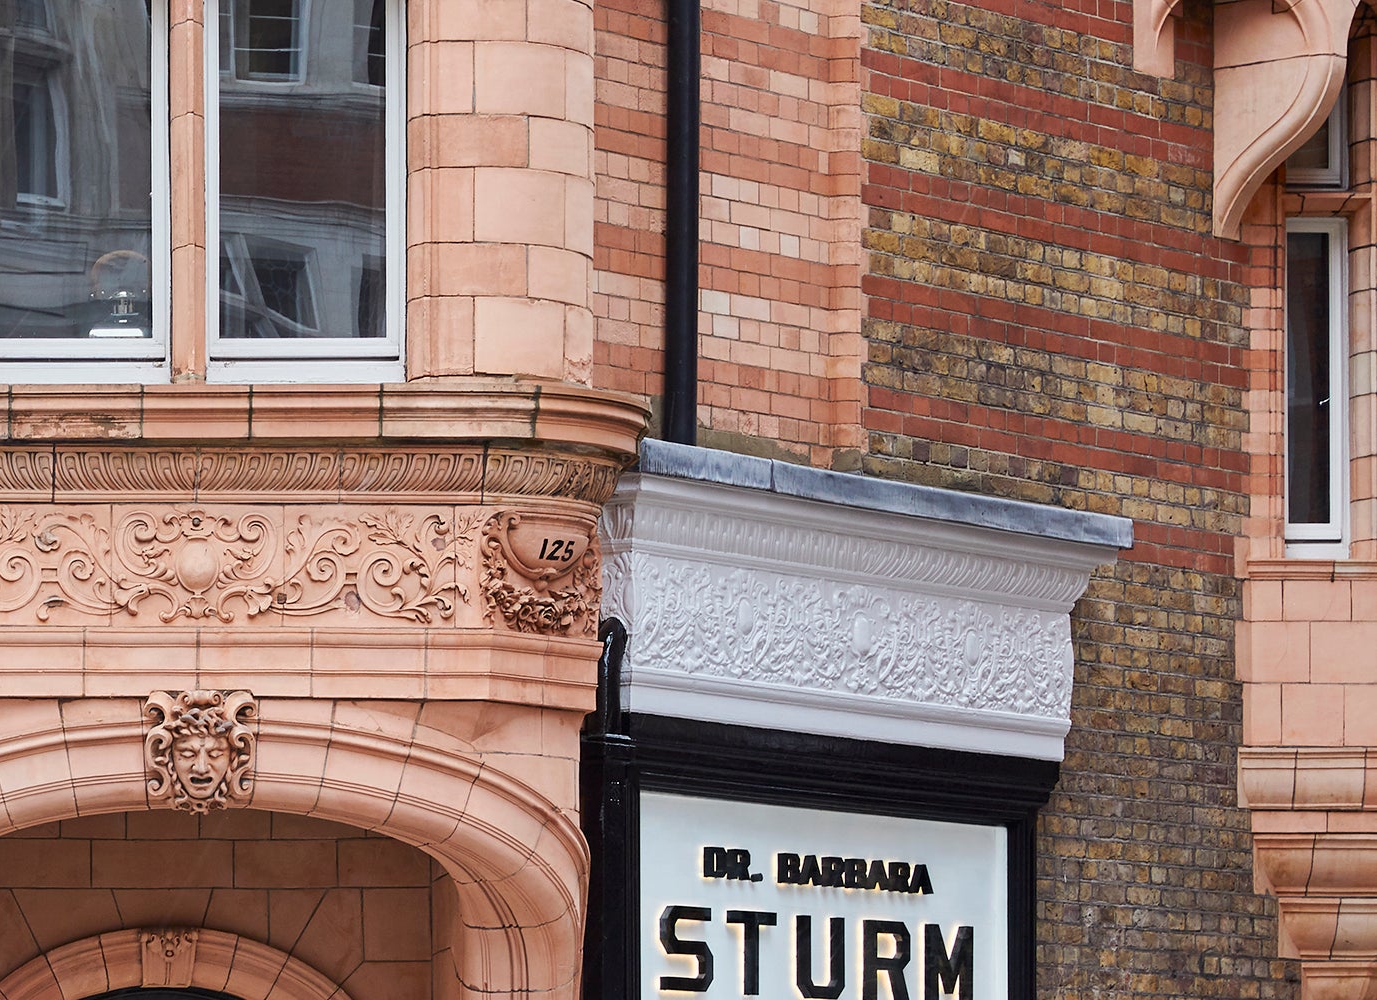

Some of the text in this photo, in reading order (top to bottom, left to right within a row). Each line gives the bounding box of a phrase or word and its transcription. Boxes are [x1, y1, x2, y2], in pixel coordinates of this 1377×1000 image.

[538, 538, 576, 562] 125
[703, 846, 935, 895] DR. BARBARA
